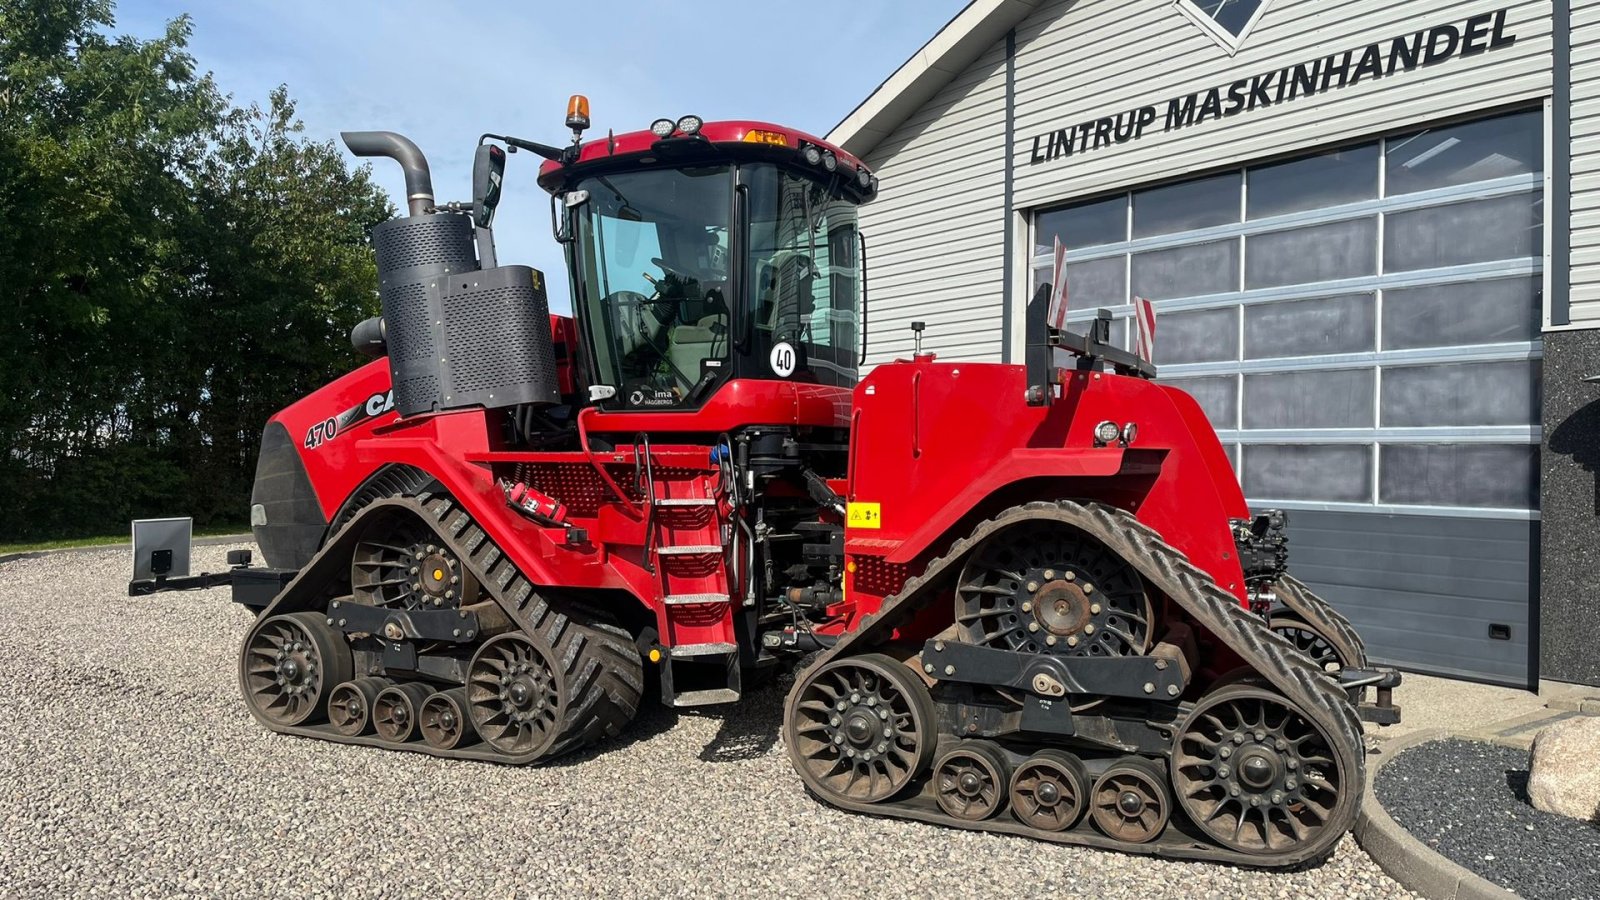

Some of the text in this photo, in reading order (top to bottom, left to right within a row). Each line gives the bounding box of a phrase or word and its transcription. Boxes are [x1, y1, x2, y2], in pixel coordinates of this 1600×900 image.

[1031, 9, 1517, 164] LINTRUP MASKINHANDEL
[776, 348, 791, 370] 40
[654, 390, 672, 398] ima
[305, 417, 337, 449] 470
